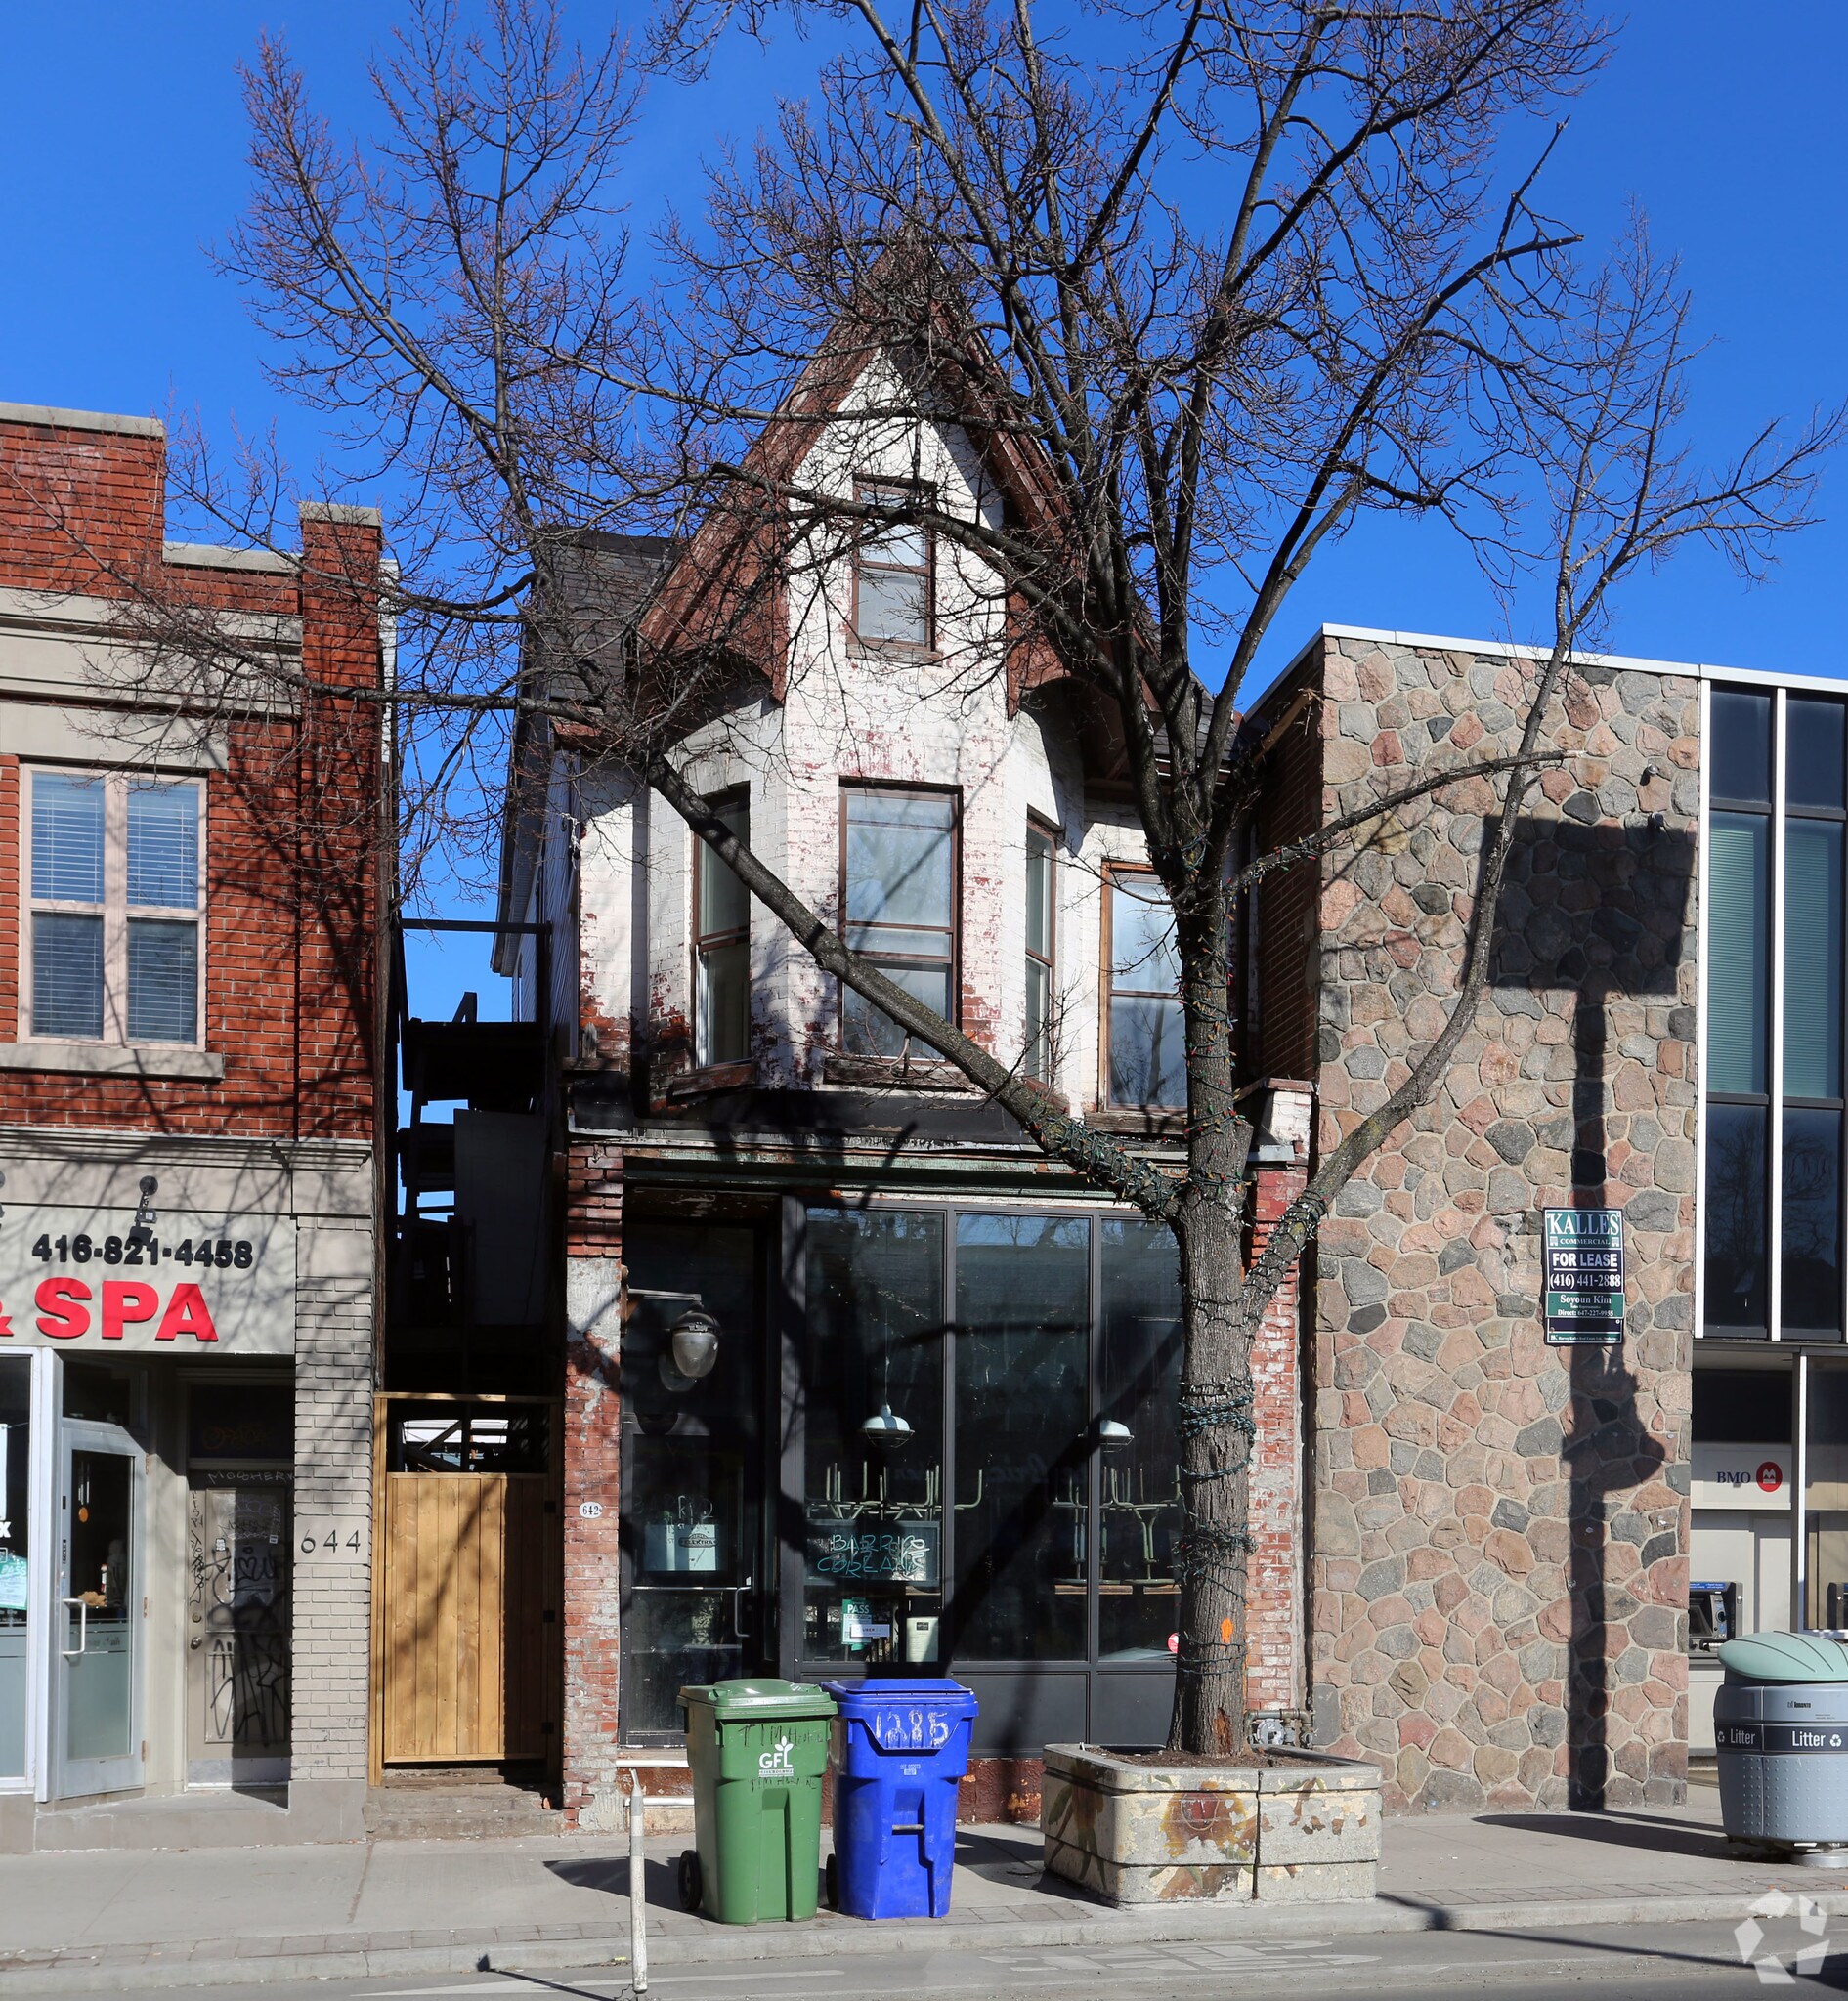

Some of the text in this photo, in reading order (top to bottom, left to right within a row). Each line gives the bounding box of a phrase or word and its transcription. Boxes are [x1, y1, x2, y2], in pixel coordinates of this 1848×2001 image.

[1548, 1213, 1619, 1235] KALLES
[1552, 1252, 1618, 1267] FOR LEASE
[1550, 1273, 1620, 1289] (416) 441-2888
[1560, 1294, 1612, 1304] Soyoun Kim
[35, 1277, 219, 1341] SPA
[1716, 1471, 1751, 1484] BMO
[582, 1506, 599, 1515] 642
[301, 1529, 361, 1554] 644
[847, 1604, 870, 1614] PASS
[876, 1710, 949, 1746] 1285
[1730, 1728, 1826, 1746] Litter Litter
[758, 1746, 794, 1769] GFL
